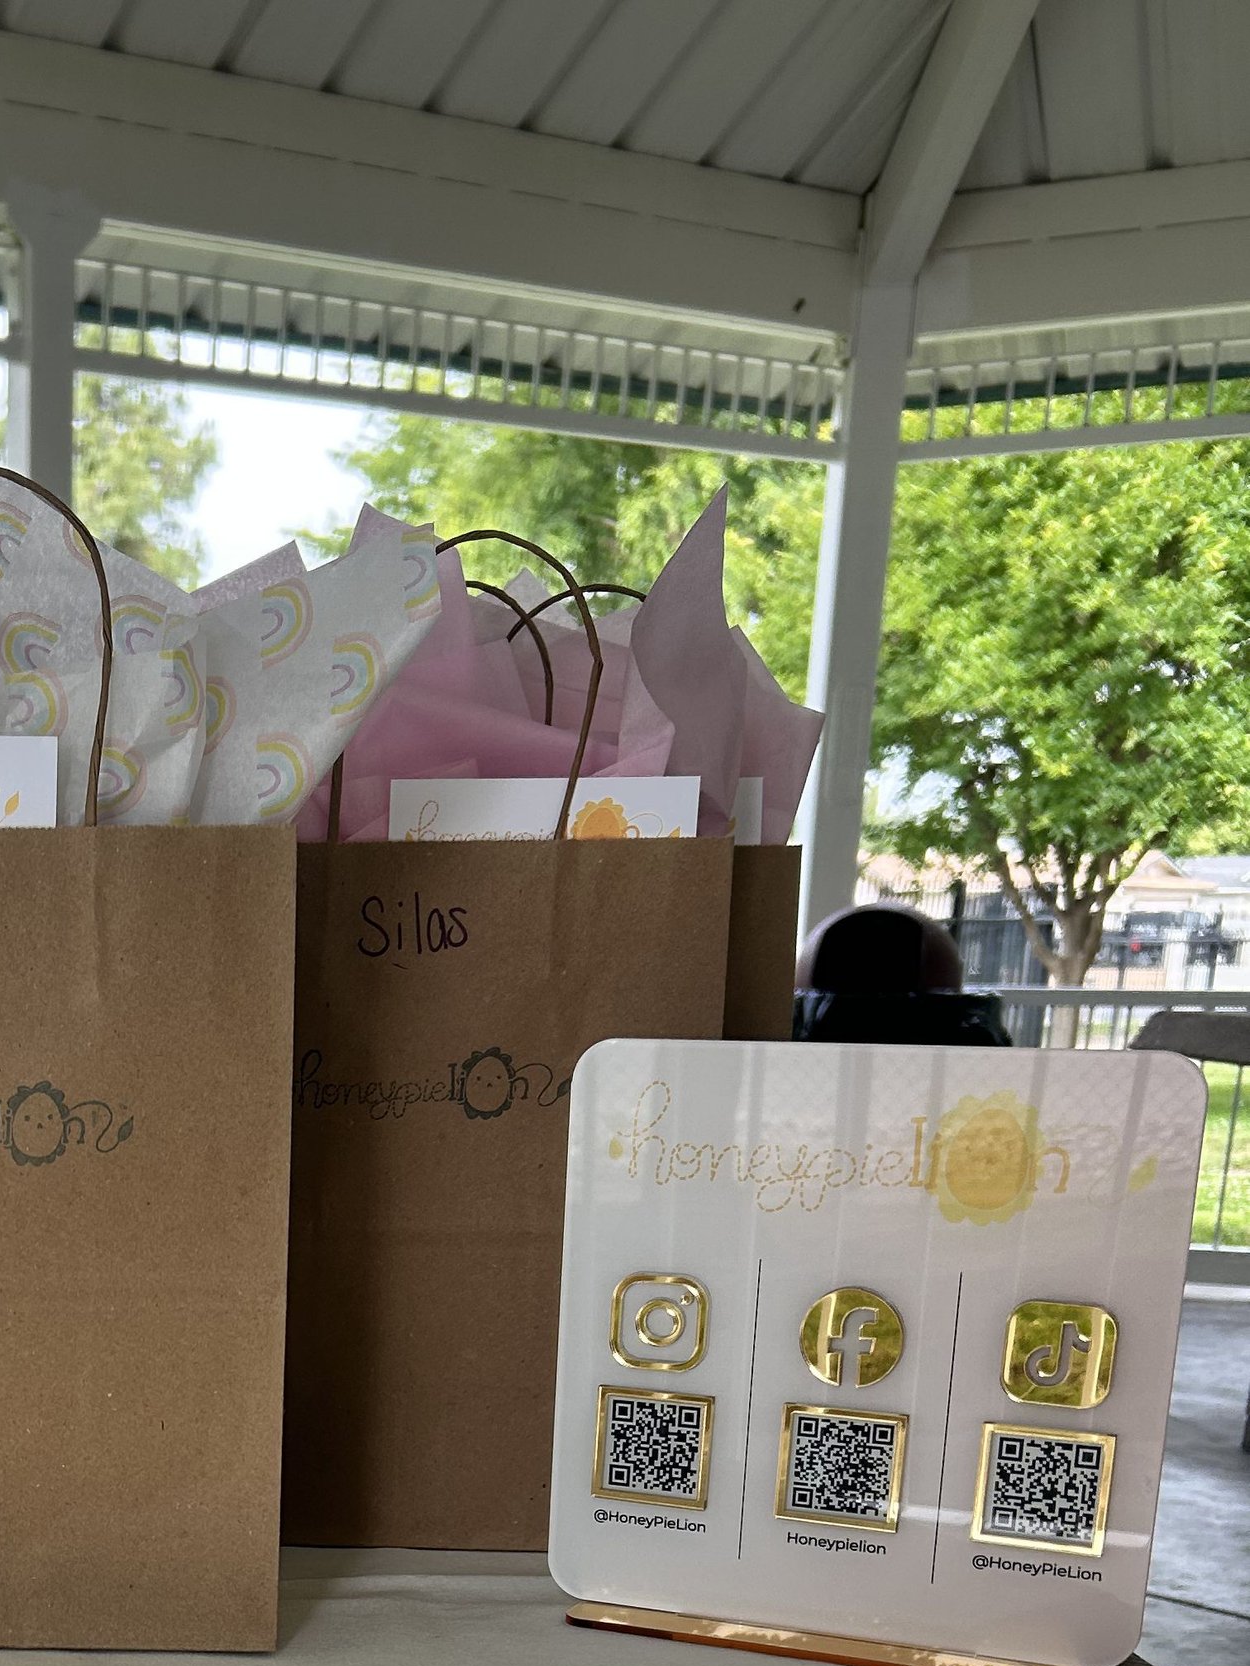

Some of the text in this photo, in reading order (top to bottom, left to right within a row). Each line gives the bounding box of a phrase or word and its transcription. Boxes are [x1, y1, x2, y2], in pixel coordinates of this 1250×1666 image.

[357, 891, 469, 957] Silas
[593, 1508, 707, 1534] @HoneyPieLion
[786, 1531, 887, 1555] Honeypielion
[971, 1554, 1103, 1582] @HoneyPieLion
